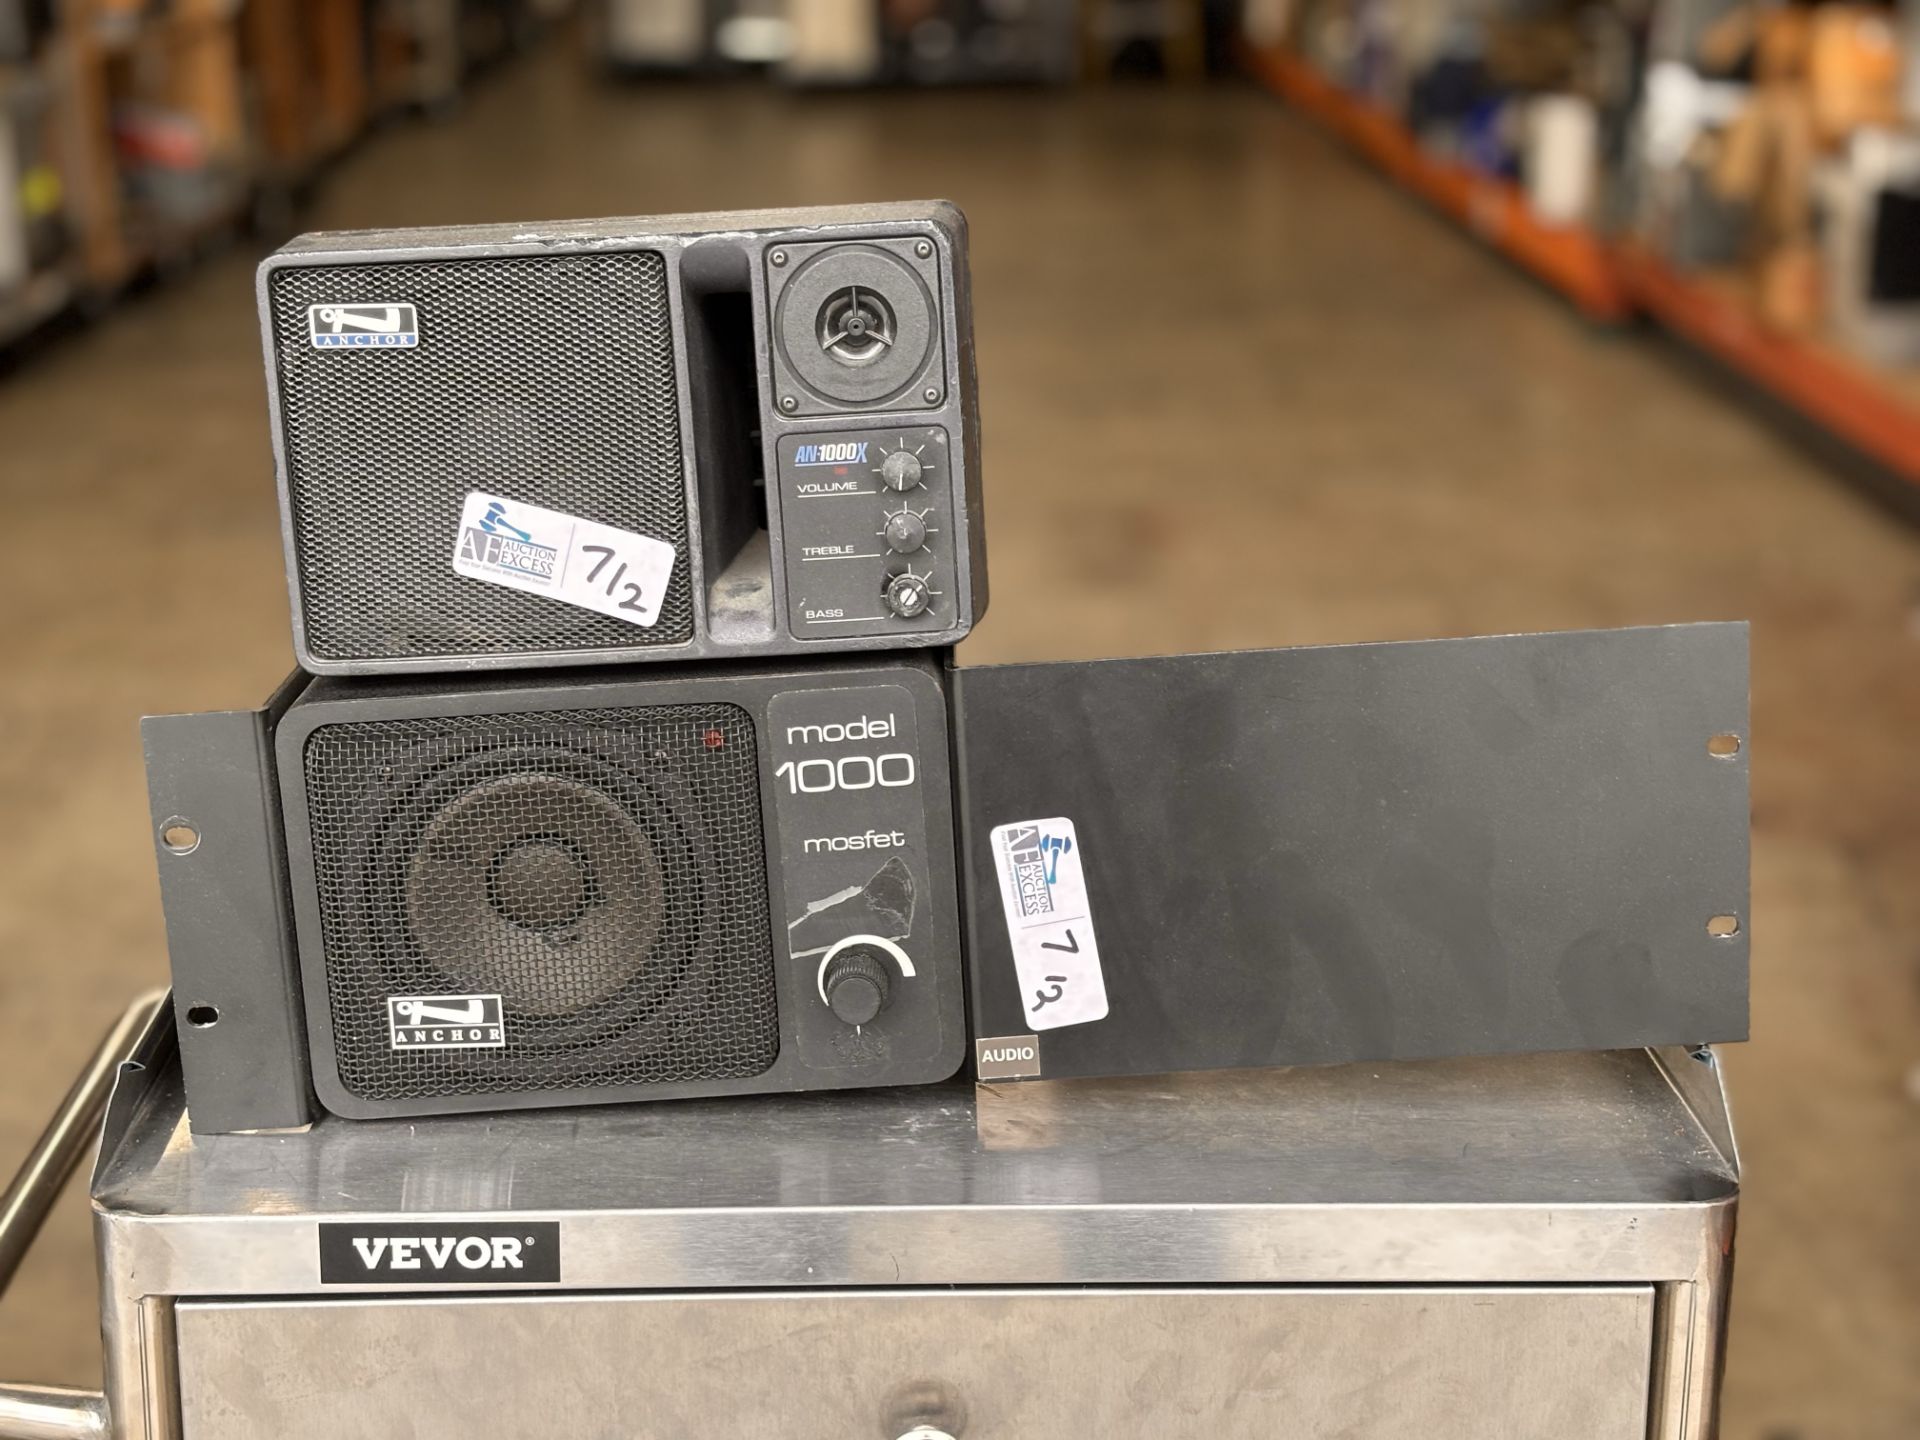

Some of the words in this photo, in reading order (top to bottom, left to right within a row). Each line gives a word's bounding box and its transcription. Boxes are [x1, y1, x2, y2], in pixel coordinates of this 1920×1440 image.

[322, 334, 410, 346] ANCHOR
[797, 481, 858, 494] VOLUME
[502, 540, 557, 563] AUCTION
[802, 545, 855, 557] TREBLE
[500, 552, 554, 576] EXCESS
[805, 608, 844, 619] BASS
[787, 713, 896, 745] model
[775, 753, 915, 795] 1000
[804, 830, 906, 853] mosfet
[1018, 864, 1040, 916] EXCESS
[1032, 863, 1051, 914] AUCTION
[396, 1028, 501, 1043] ANCHOR
[981, 1046, 1035, 1063] AUDIO
